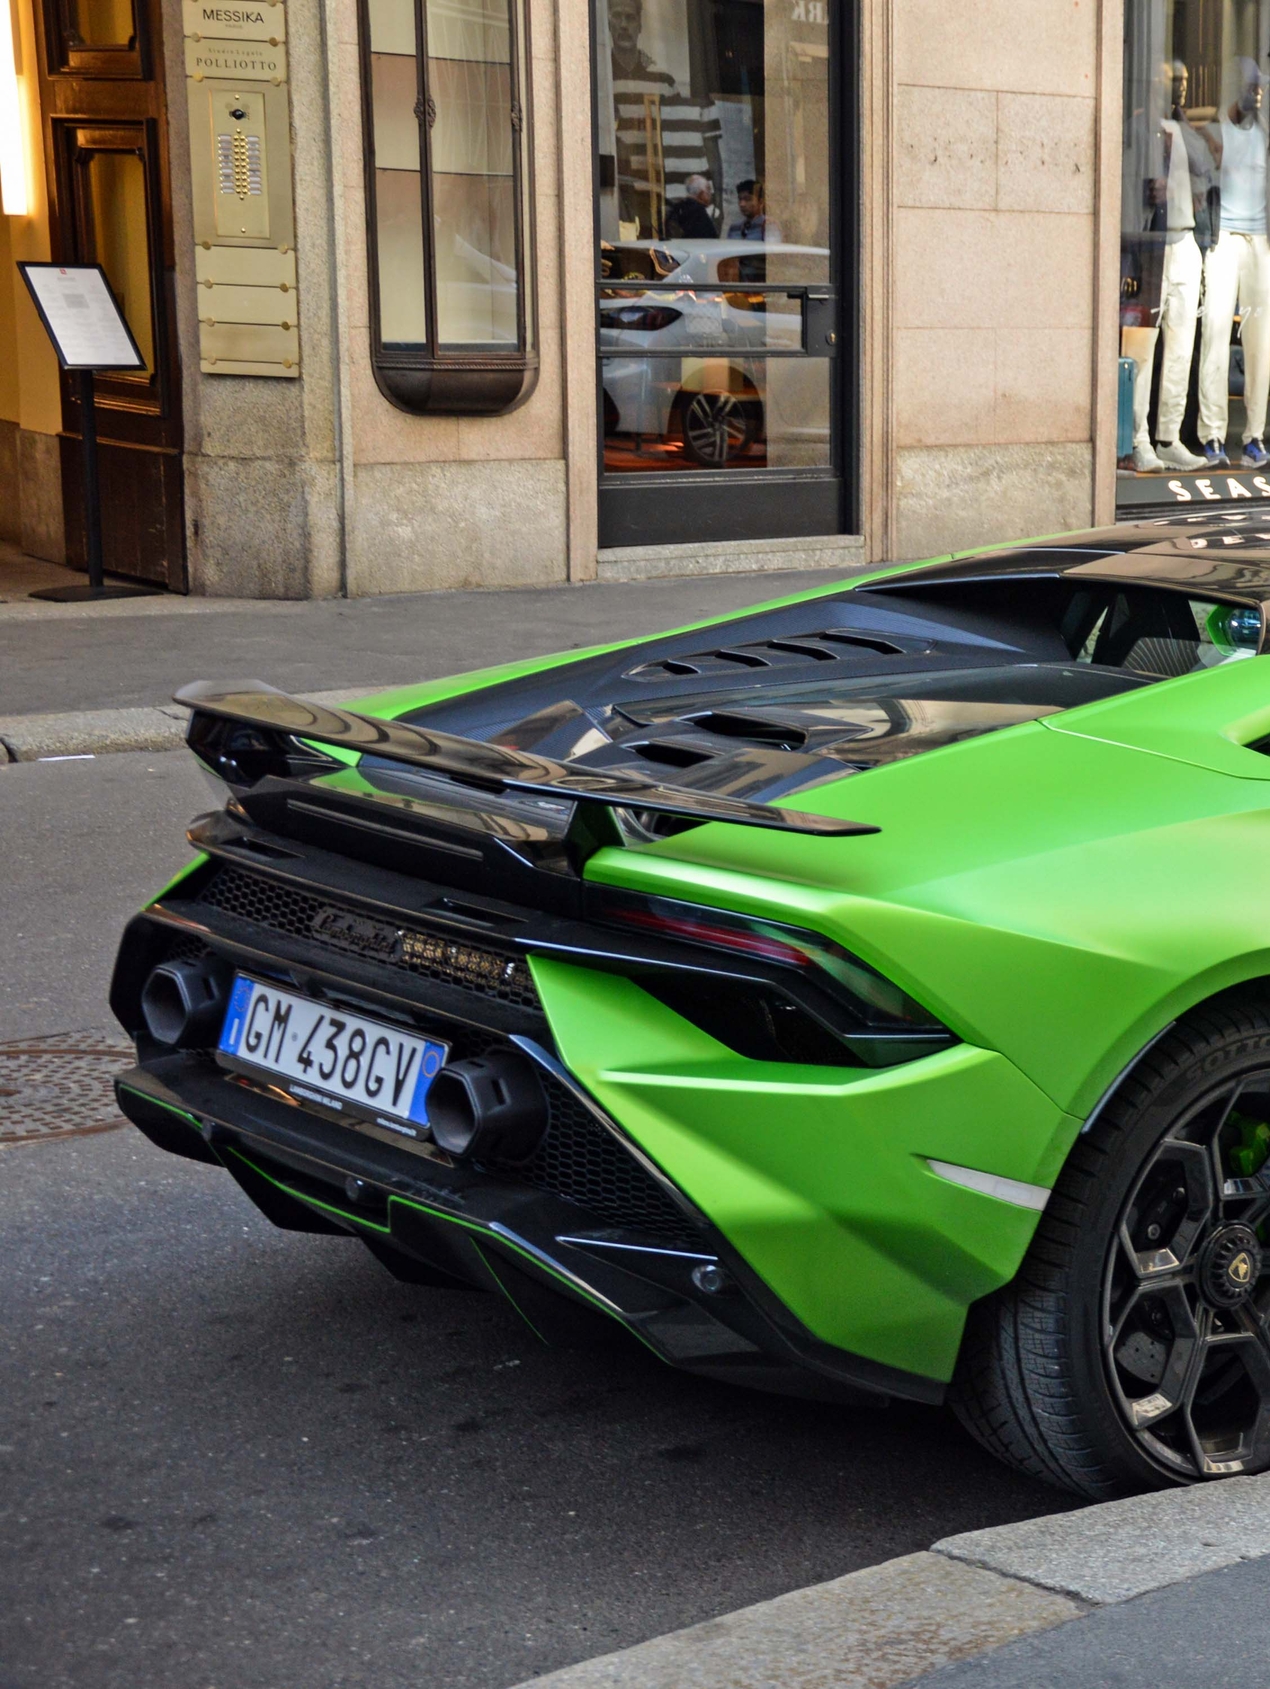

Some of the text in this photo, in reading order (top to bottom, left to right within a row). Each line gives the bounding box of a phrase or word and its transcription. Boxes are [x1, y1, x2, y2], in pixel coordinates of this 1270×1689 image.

[202, 8, 264, 23] MESSIKA
[196, 57, 277, 71] POLLIOTTO
[245, 993, 293, 1064] GM
[297, 1014, 417, 1107] 438GV
